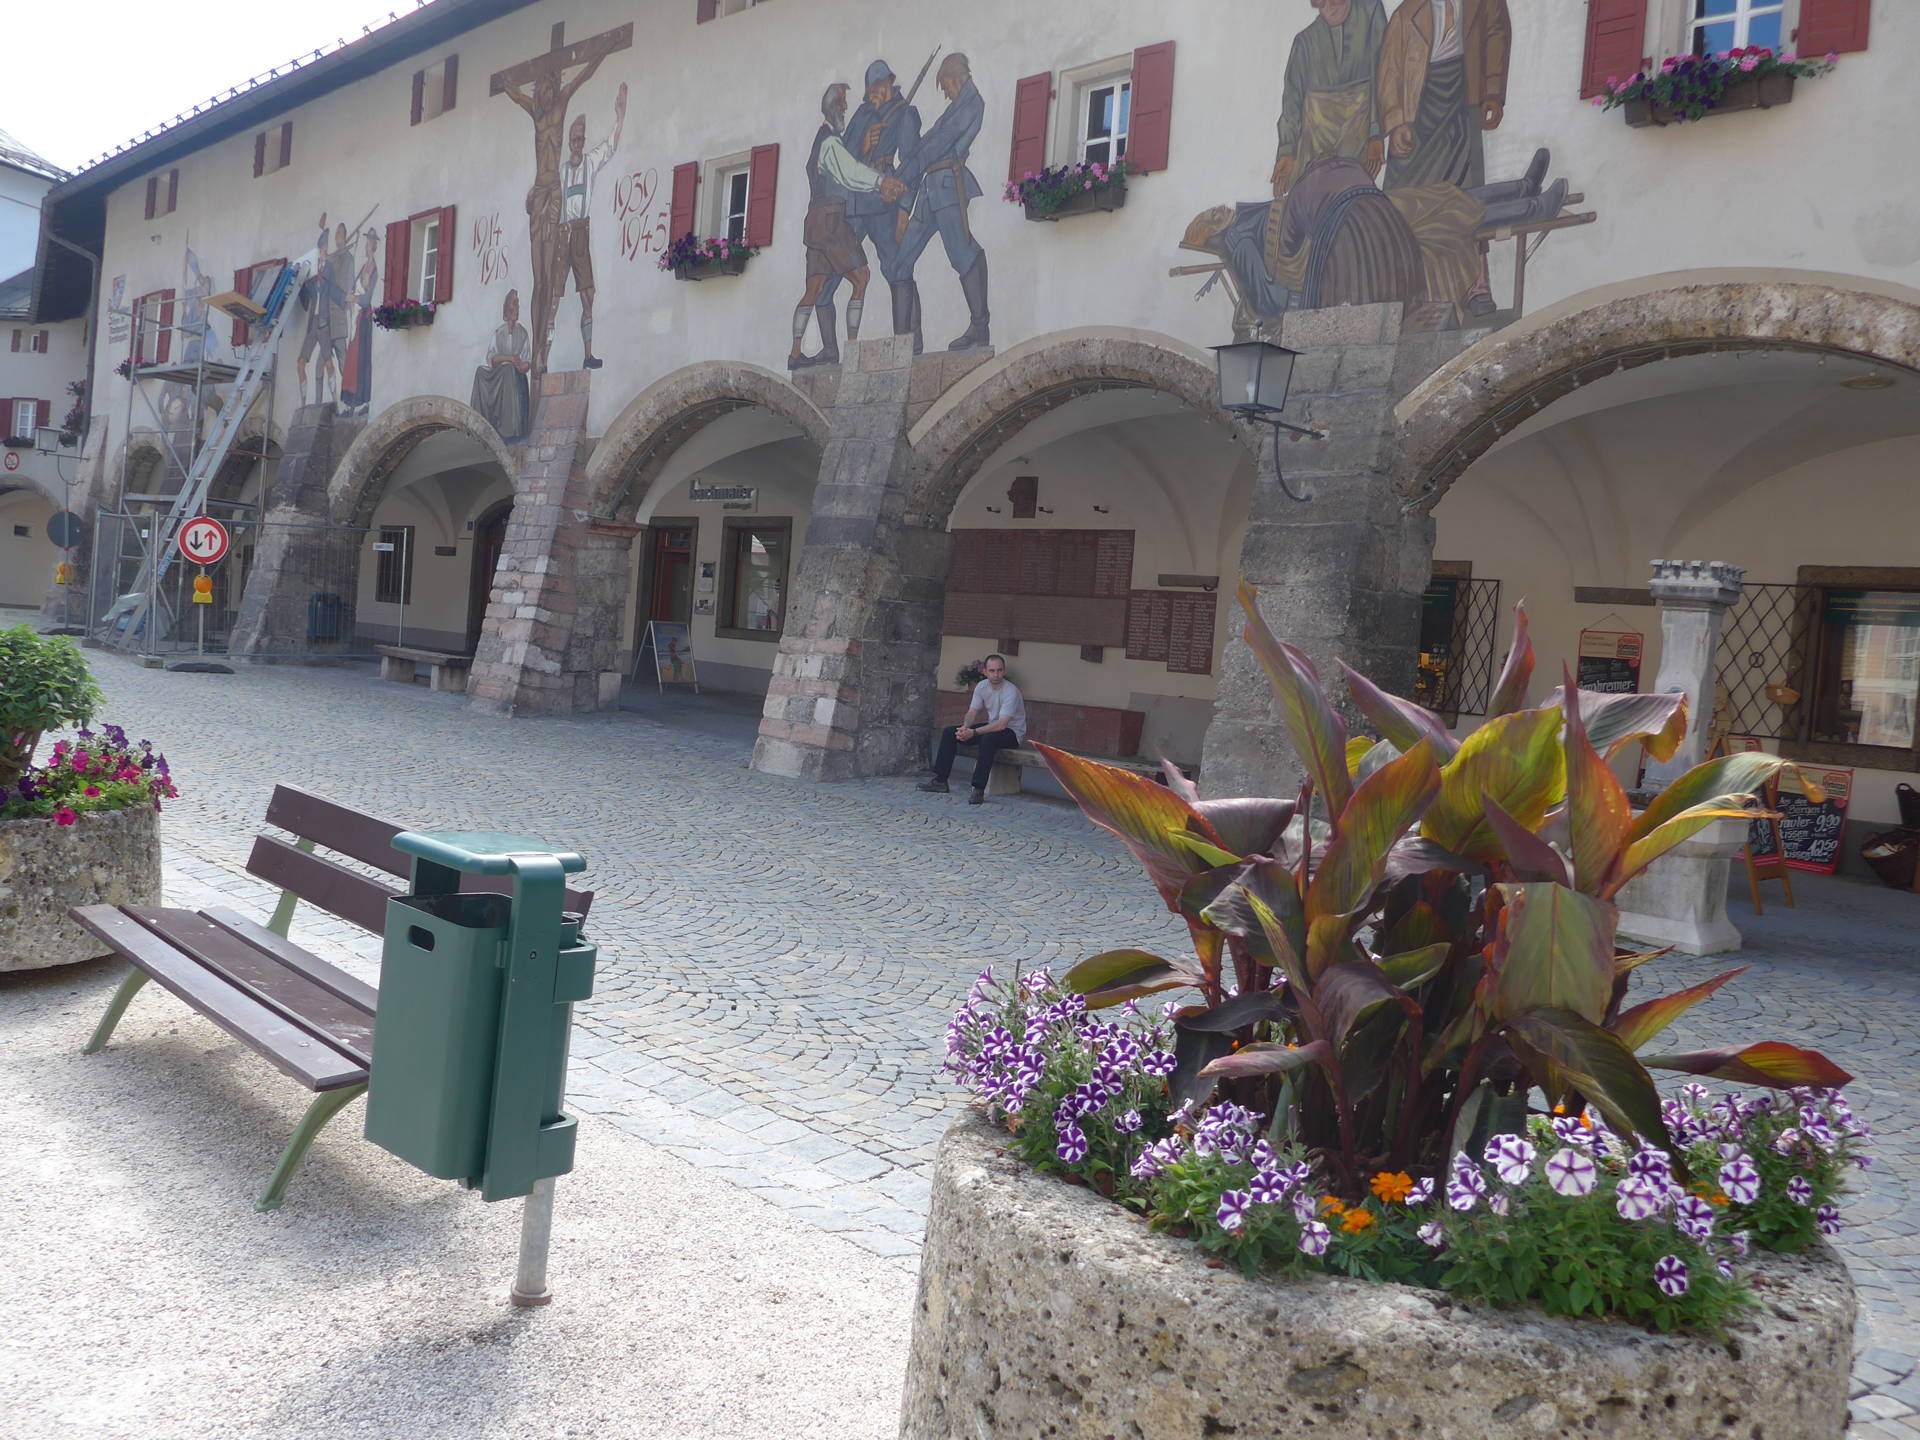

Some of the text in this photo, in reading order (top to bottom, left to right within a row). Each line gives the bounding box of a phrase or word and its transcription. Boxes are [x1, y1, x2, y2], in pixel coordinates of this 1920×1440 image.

[613, 167, 658, 221] 1939
[473, 212, 502, 257] 1914
[621, 212, 667, 262] 1945
[480, 245, 509, 286] 1918
